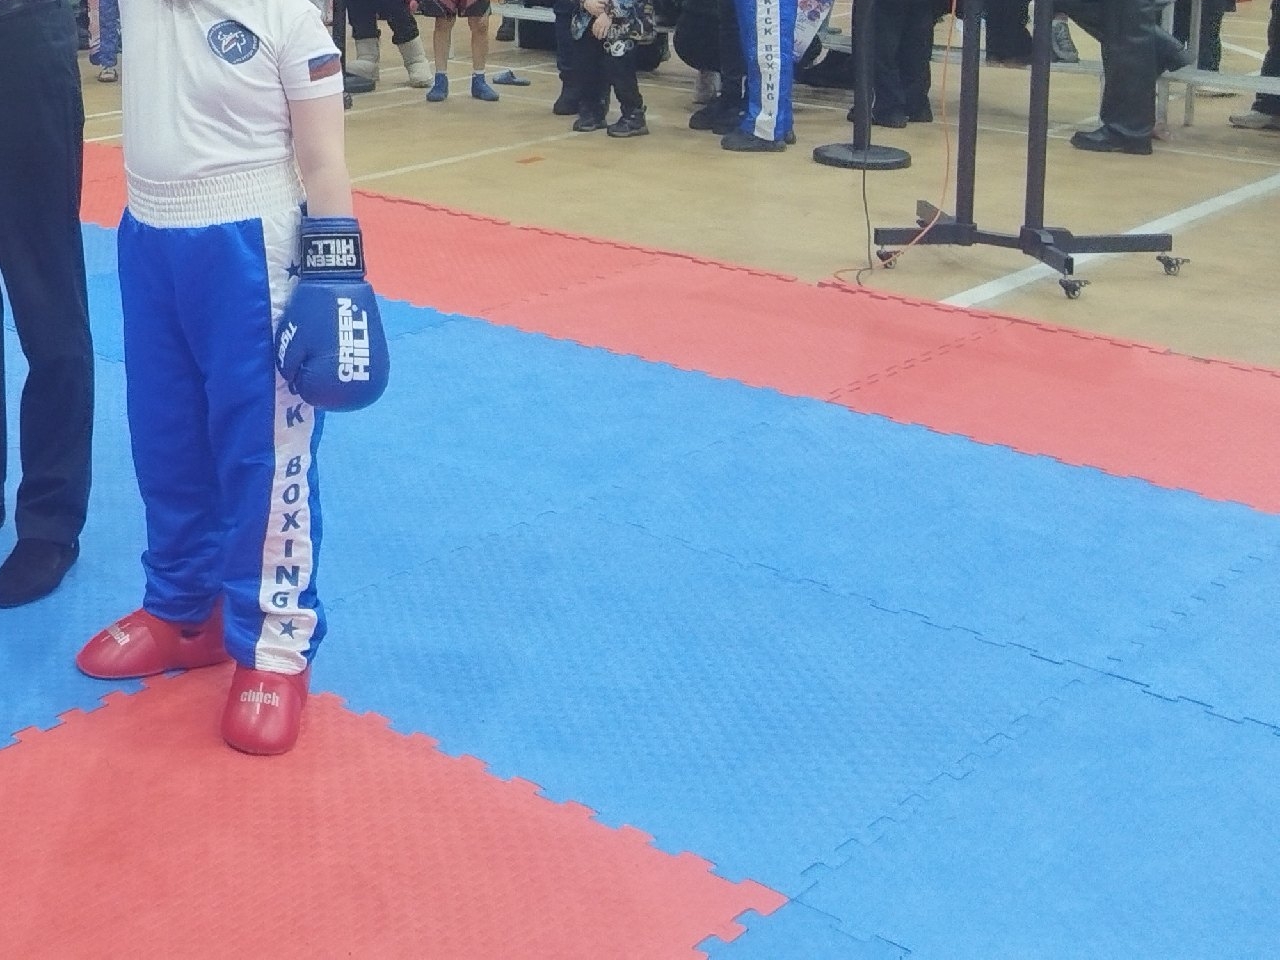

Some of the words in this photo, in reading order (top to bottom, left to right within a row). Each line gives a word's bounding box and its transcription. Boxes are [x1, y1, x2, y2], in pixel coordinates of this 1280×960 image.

[764, 44, 775, 101] BOXING
[306, 254, 357, 268] GREEN
[311, 239, 354, 254] HILL
[336, 297, 355, 383] GREEN
[353, 309, 370, 382] HILL
[271, 455, 302, 609] BOXING
[239, 689, 280, 708] clinch
